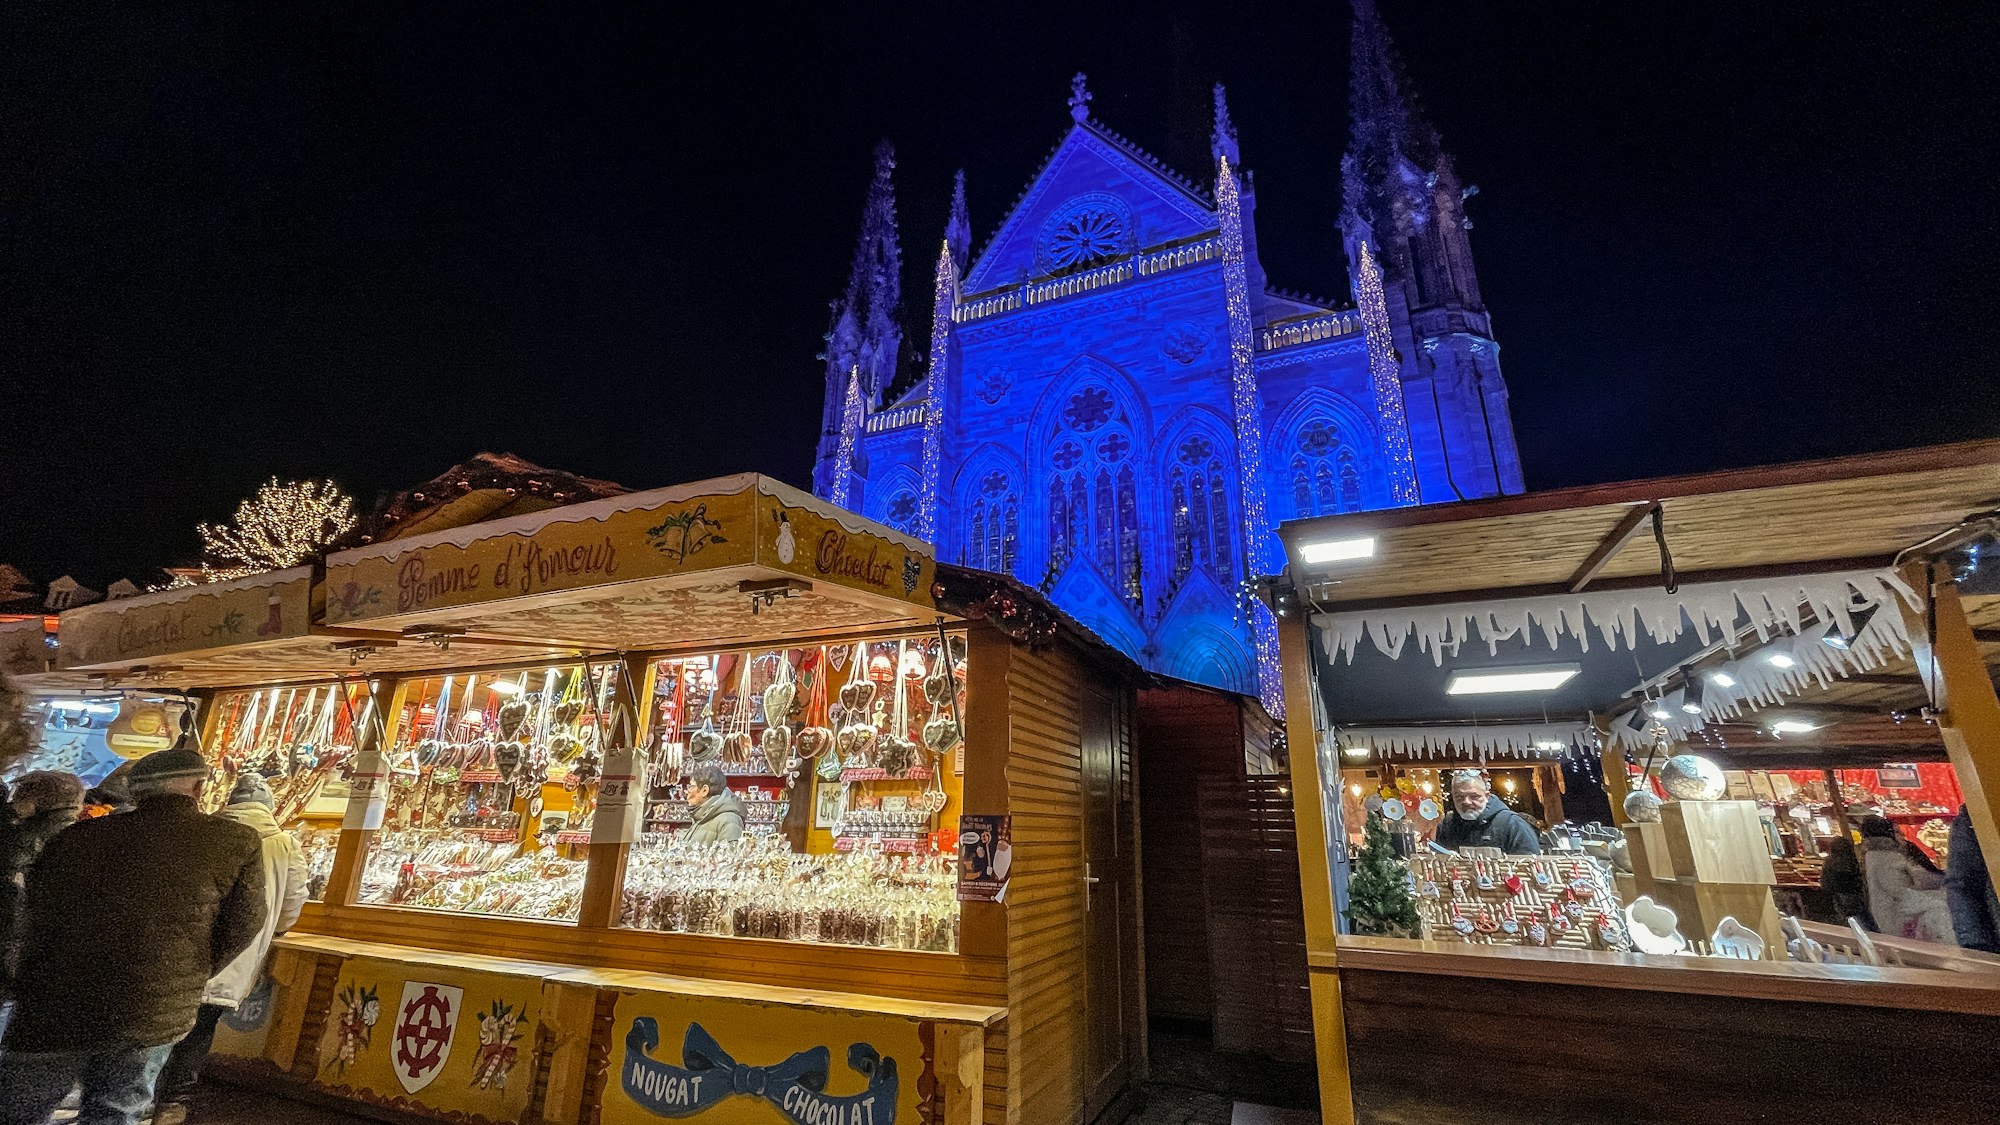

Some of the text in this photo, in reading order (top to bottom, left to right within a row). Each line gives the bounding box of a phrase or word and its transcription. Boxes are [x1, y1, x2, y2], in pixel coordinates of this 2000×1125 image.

[398, 536, 619, 610] Pomme d'Amour
[815, 530, 894, 589] Chocolat
[631, 1062, 702, 1105] NOUGAT
[783, 1085, 875, 1125] CHOCOLAT
